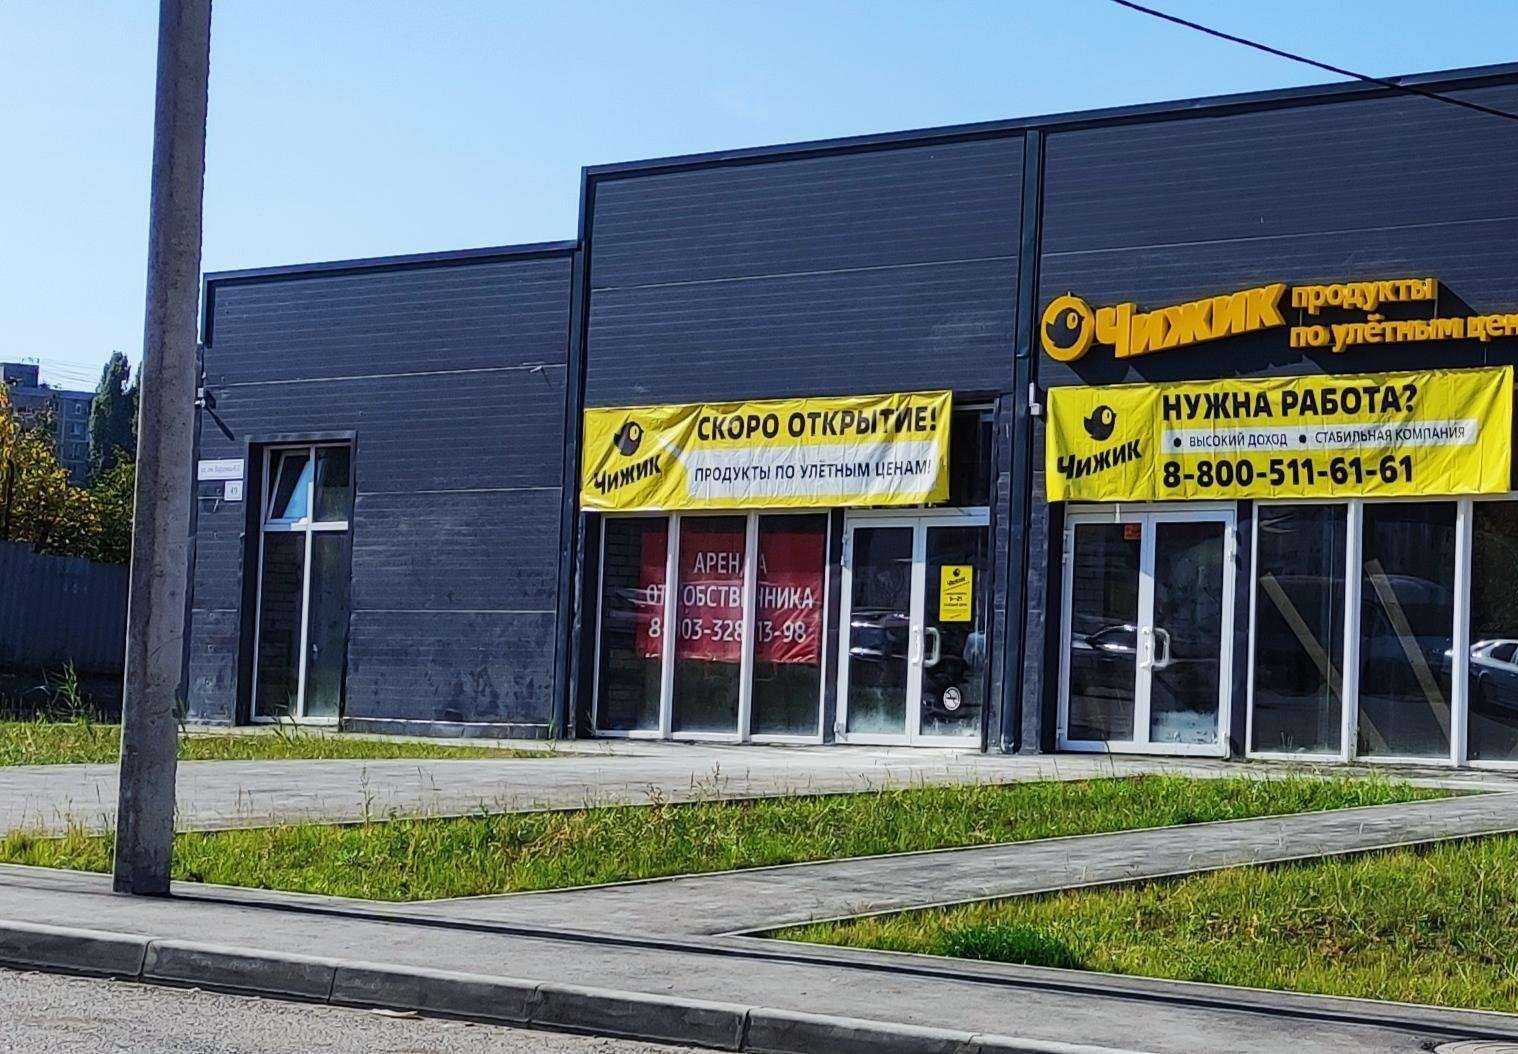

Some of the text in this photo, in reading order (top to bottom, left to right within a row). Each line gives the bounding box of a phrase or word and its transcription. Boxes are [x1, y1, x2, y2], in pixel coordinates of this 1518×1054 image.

[1292, 278, 1438, 314] продукты
[1290, 323, 1330, 347] по
[1332, 314, 1464, 352] улётным
[1163, 384, 1418, 421] НУЖНА РАБОТА?
[697, 406, 937, 441] СКОРО ОТКРЫТИЕ!
[1189, 431, 1288, 447] ВЫСОКИЙ ДОХОД
[1315, 426, 1465, 444] СТАБИЛЬНАЯ КОМПАНИЯ
[593, 454, 664, 495] Чижик
[694, 464, 771, 484] ПРОДУКТЫ
[775, 464, 795, 480] ПО
[875, 459, 932, 479] ЦЕНАМ!
[1057, 438, 1142, 480] Чижик
[1163, 454, 1413, 488] 8-800-511-61-61
[693, 551, 768, 577] АРЕНА
